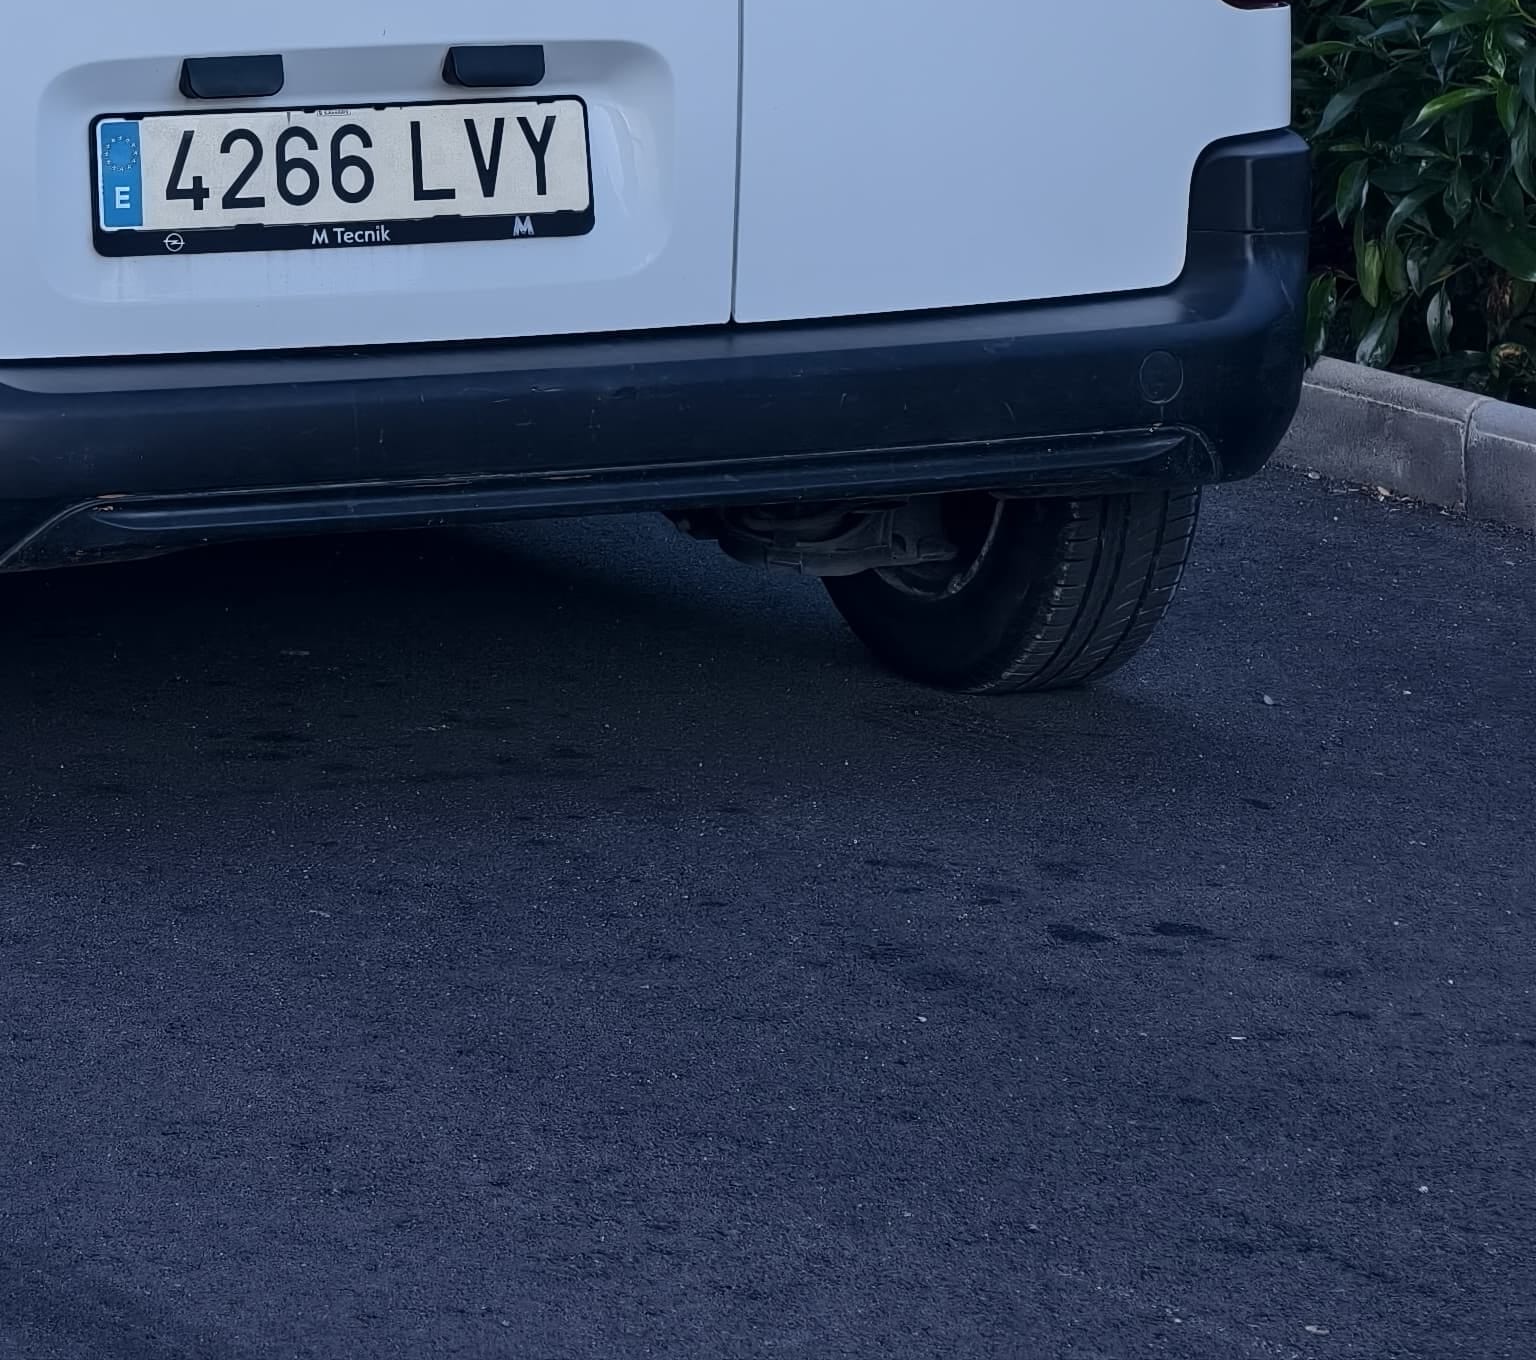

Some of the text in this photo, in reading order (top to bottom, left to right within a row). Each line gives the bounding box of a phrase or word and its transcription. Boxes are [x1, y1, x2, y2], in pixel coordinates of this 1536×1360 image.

[165, 115, 558, 211] 4266 LVY
[115, 186, 131, 209] E
[312, 224, 391, 245] M Tecnik
[513, 216, 535, 237] M
